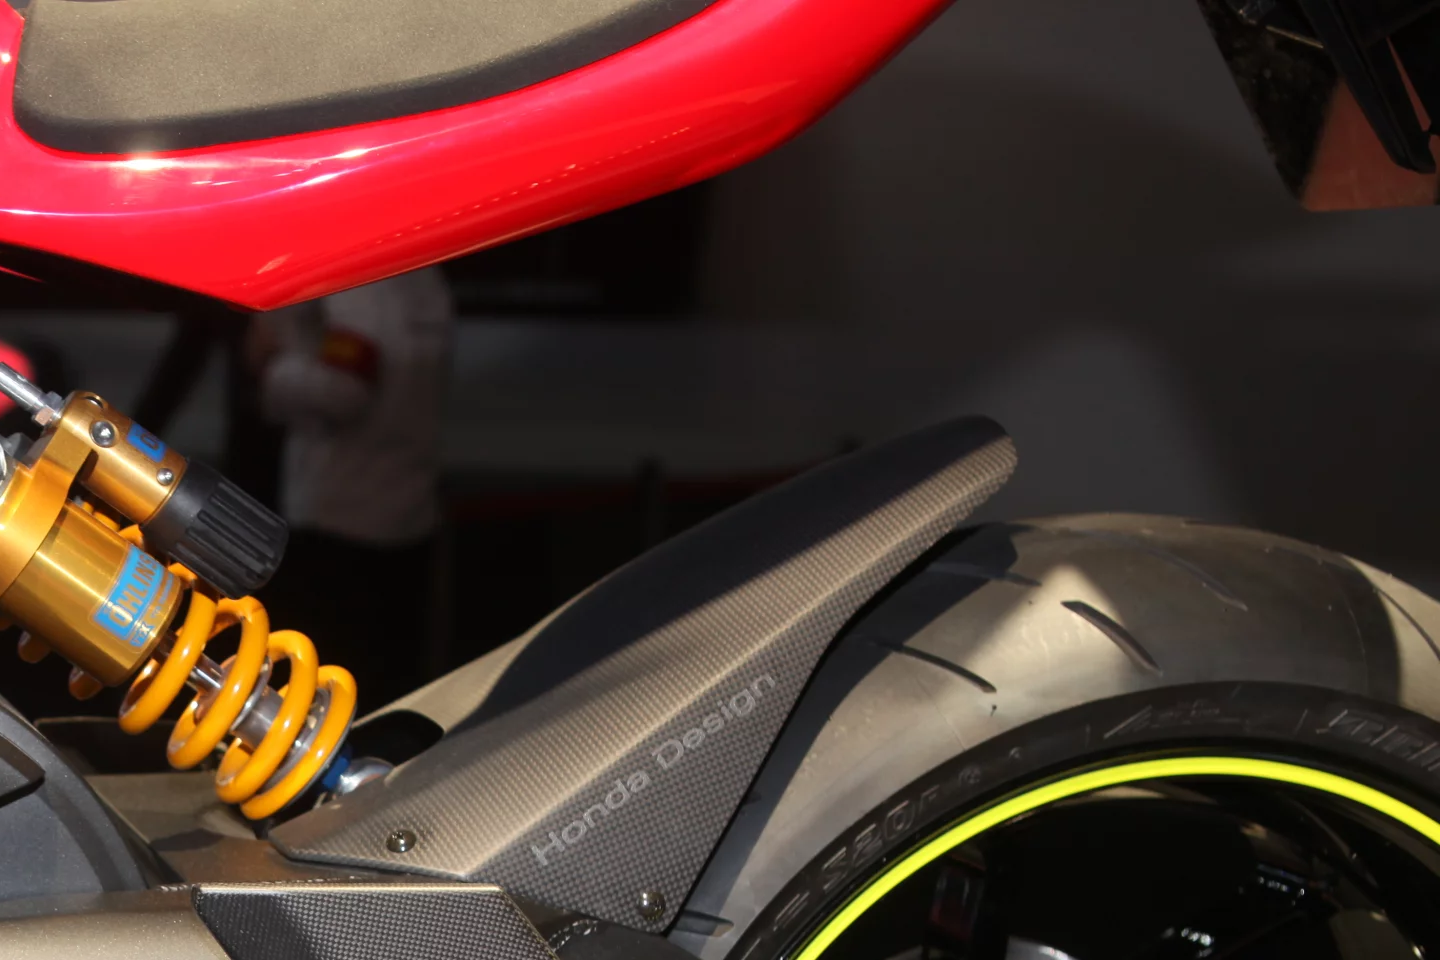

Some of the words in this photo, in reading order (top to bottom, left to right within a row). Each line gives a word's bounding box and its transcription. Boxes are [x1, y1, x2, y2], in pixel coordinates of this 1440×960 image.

[103, 553, 158, 628] ÖHLINS
[531, 770, 651, 866] Honda
[652, 673, 776, 769] Design
